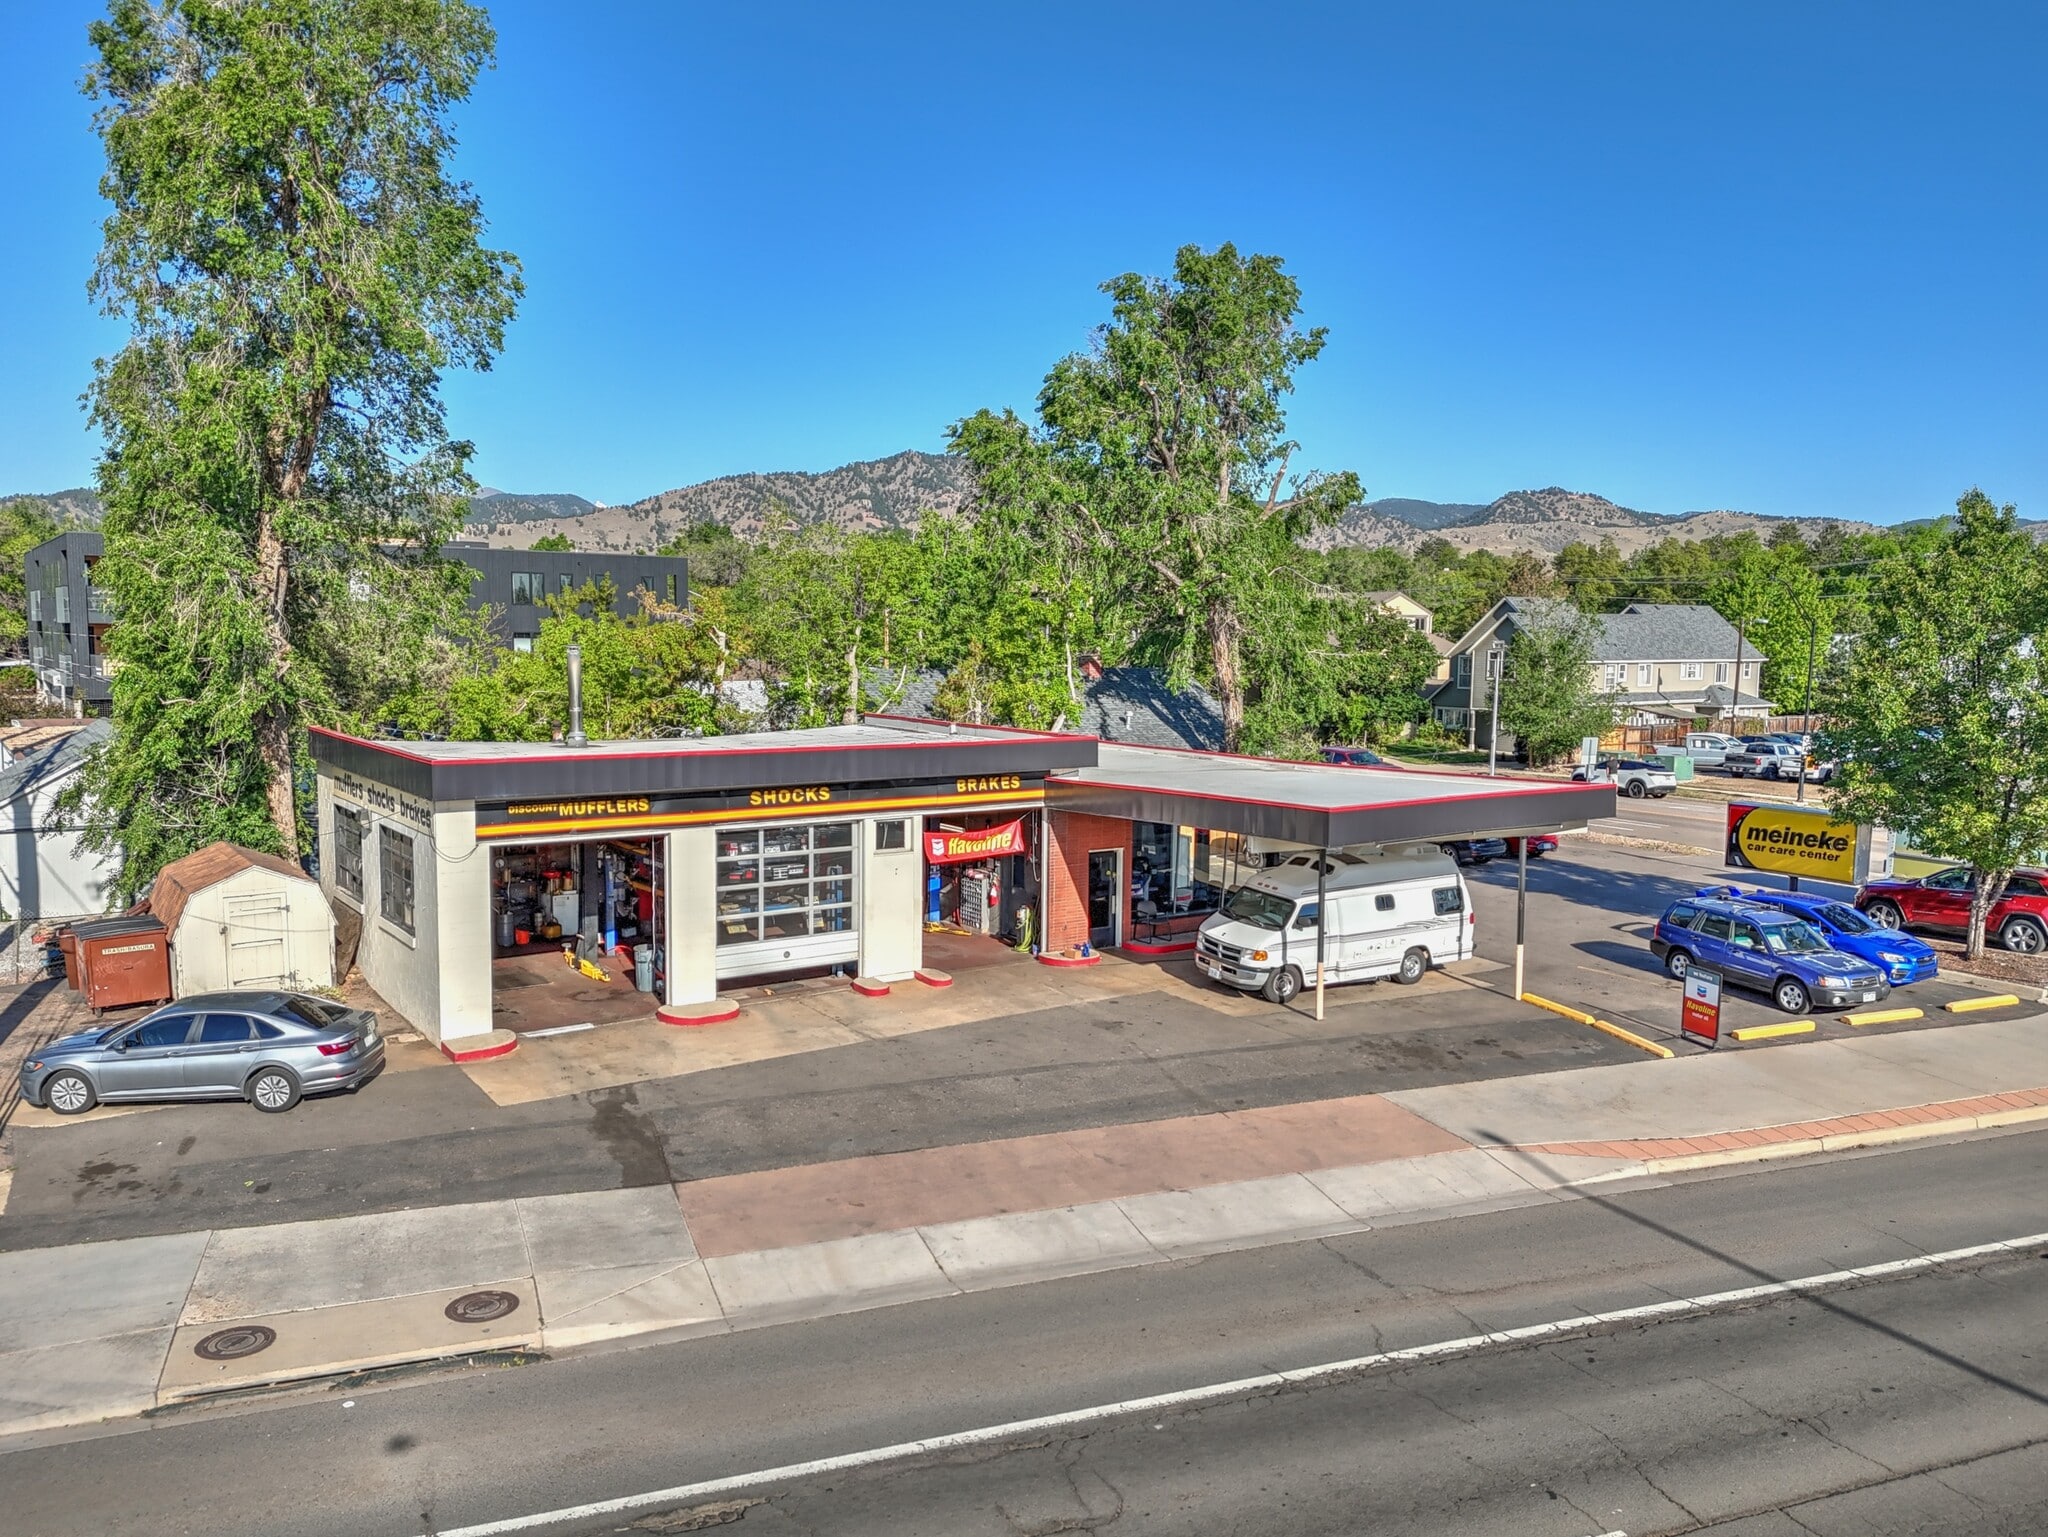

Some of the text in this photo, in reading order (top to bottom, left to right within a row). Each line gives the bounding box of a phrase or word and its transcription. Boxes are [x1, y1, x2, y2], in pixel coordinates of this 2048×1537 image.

[956, 775, 1021, 793] BRAKES
[334, 773, 431, 828] mufflers shocks brakes
[750, 787, 831, 806] SHOCKS
[508, 798, 649, 817] DISCOUNT MUFFLERS
[948, 832, 1012, 856] Havoline
[1746, 826, 1849, 852] meineke
[1747, 842, 1840, 863] car care center
[1686, 1000, 1717, 1017] Havoline
